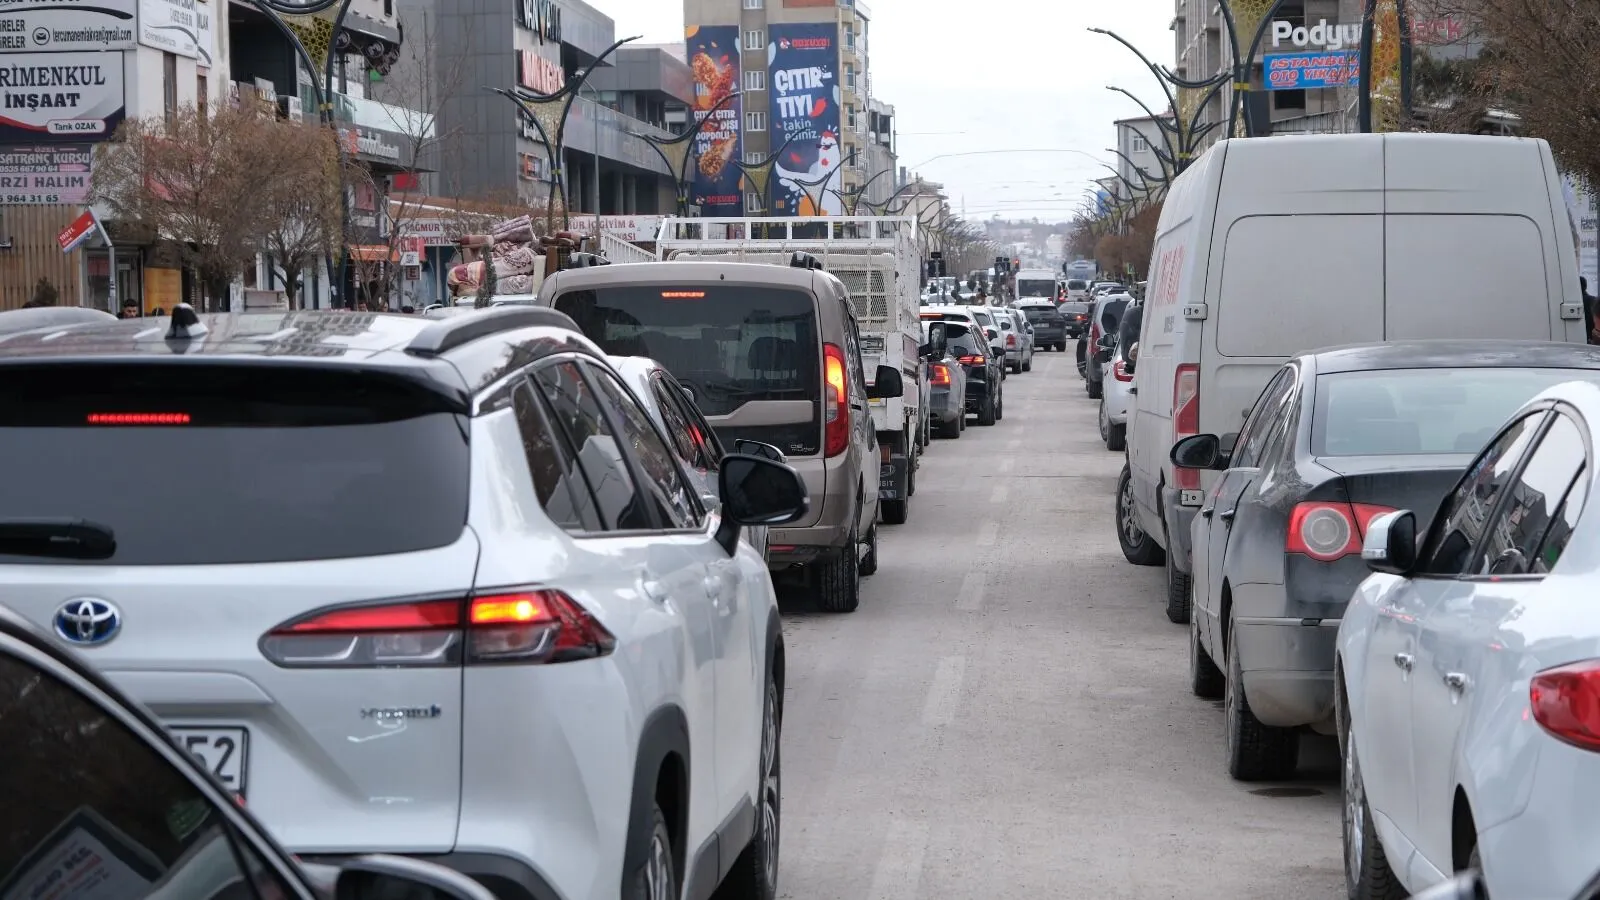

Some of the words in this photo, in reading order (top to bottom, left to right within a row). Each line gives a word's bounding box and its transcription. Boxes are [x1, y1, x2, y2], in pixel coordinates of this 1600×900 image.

[1272, 19, 1381, 50] Podyu
[0, 63, 105, 88] RİMENKUL
[1270, 69, 1298, 81] OTO
[5, 90, 80, 112] İNŞAAT
[777, 94, 813, 118] TIYI
[0, 153, 50, 165] SATRANÇ
[53, 153, 90, 163] KURSU
[628, 219, 635, 228] &
